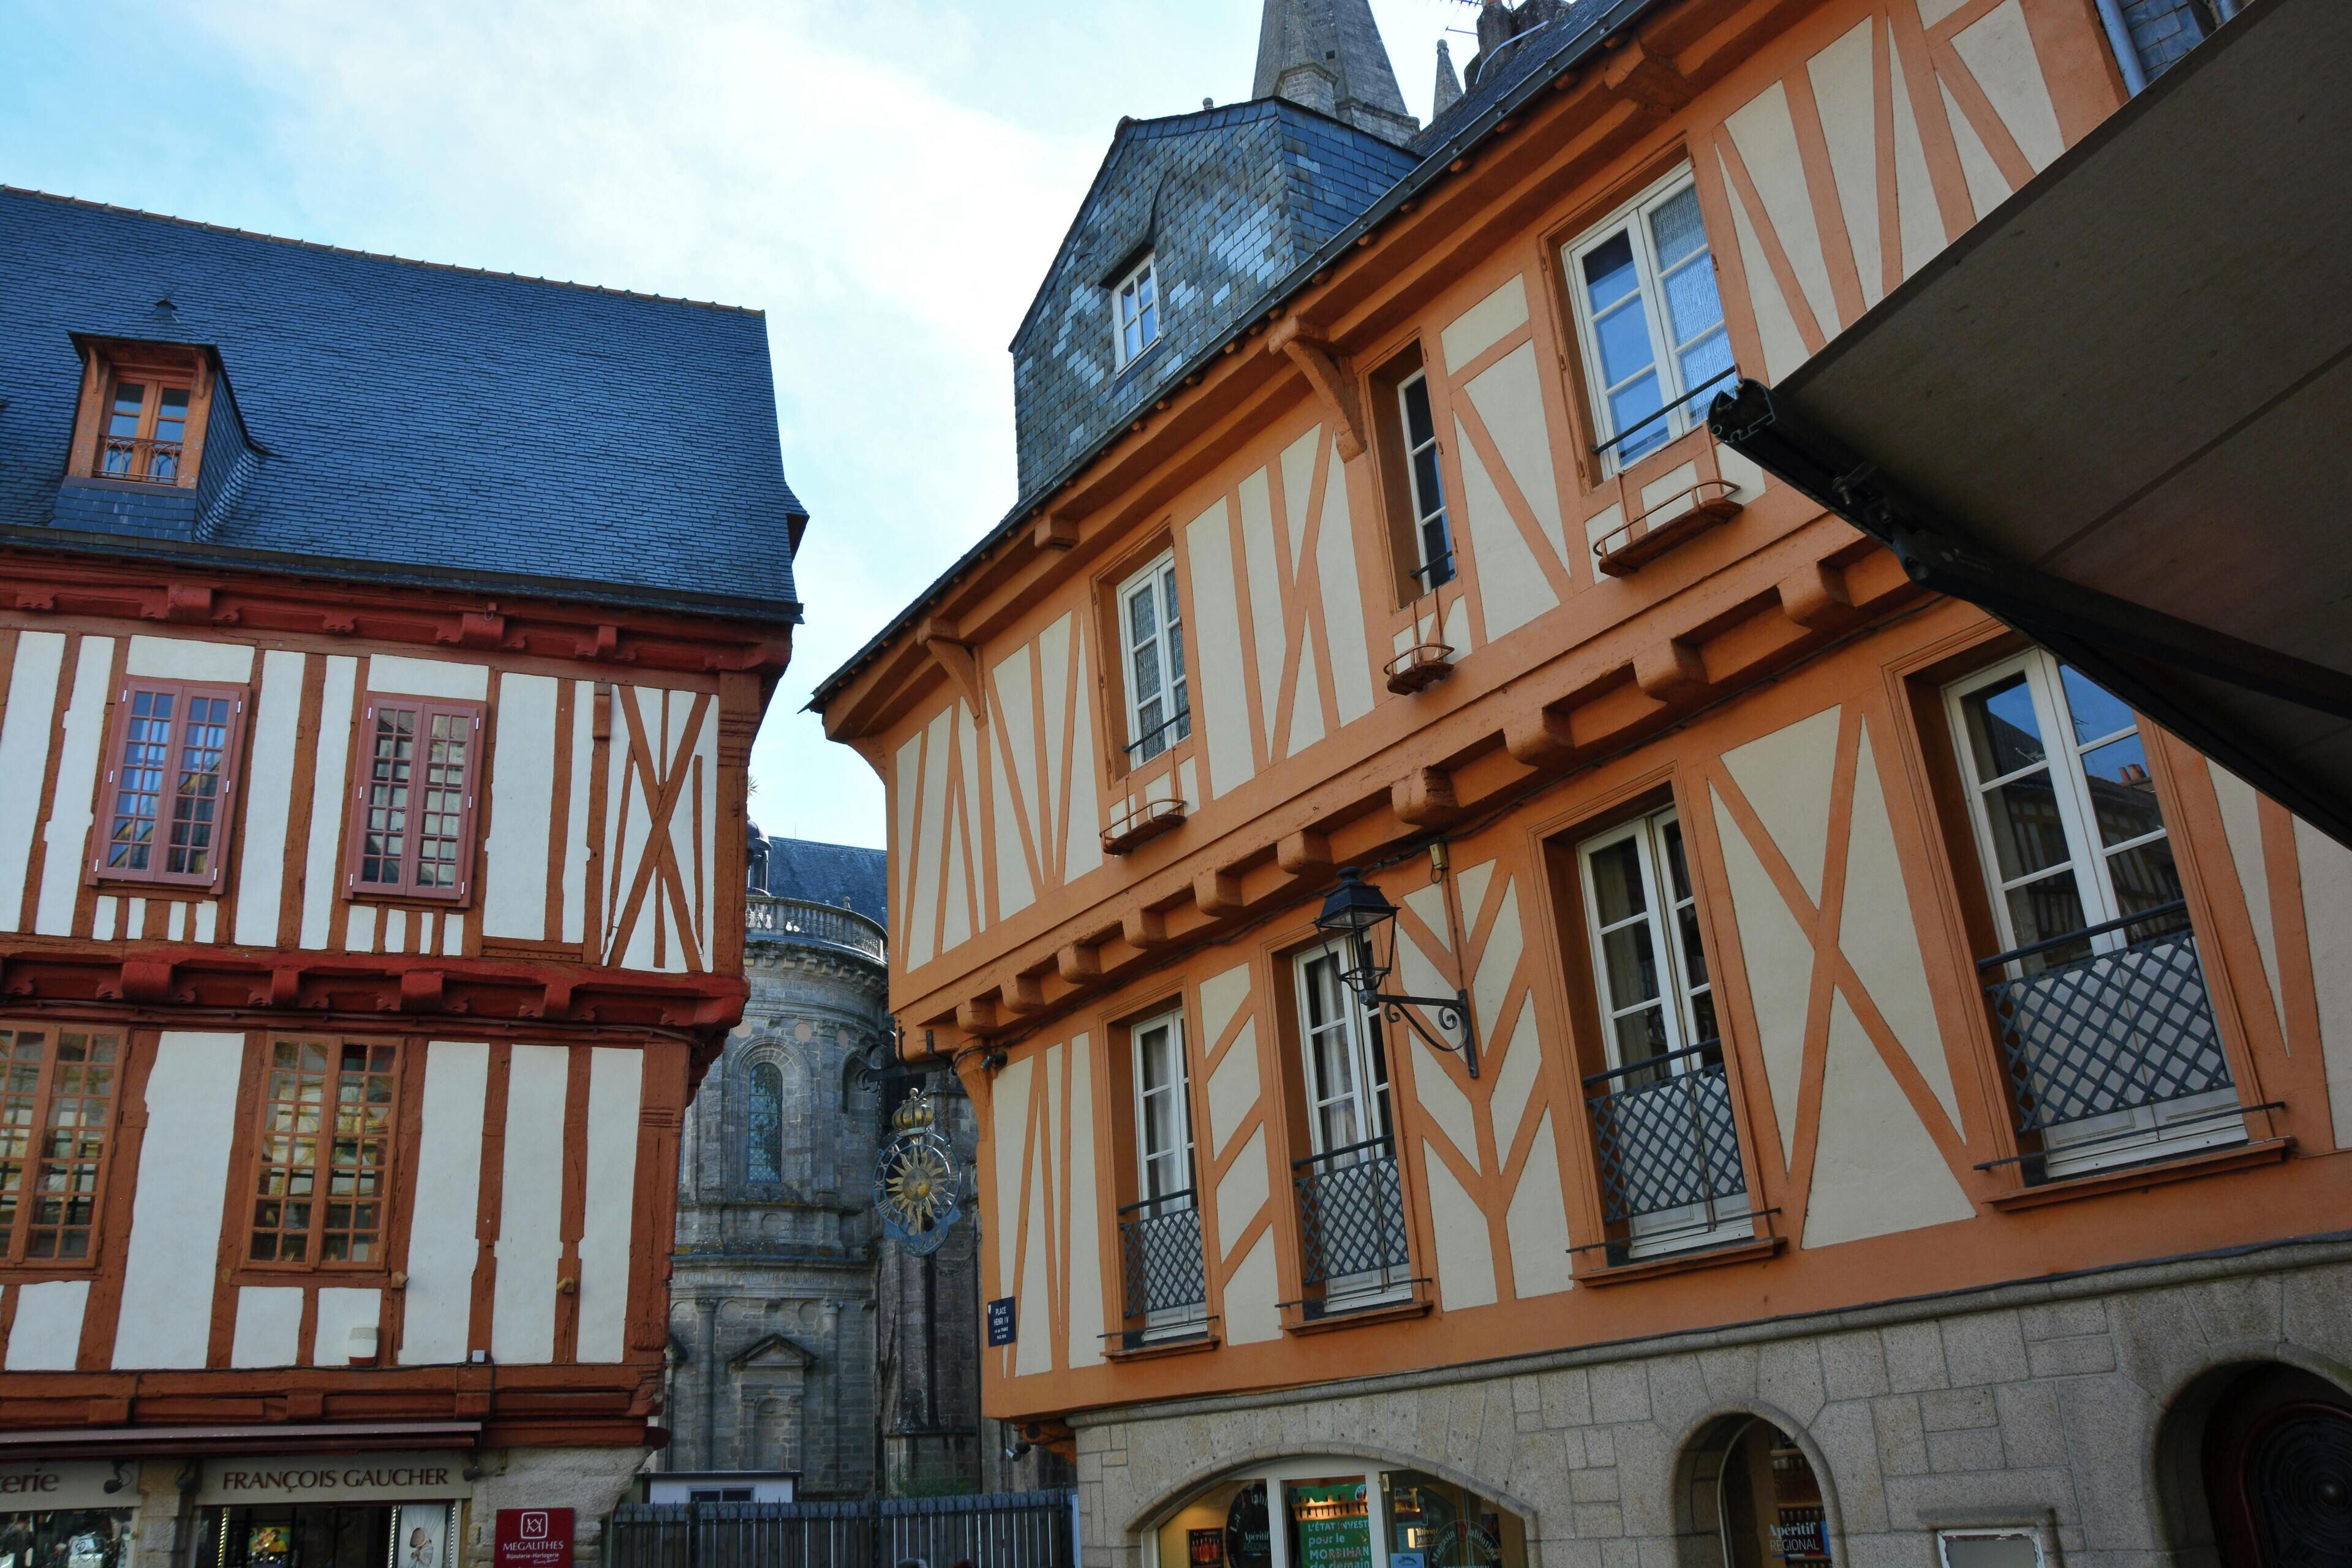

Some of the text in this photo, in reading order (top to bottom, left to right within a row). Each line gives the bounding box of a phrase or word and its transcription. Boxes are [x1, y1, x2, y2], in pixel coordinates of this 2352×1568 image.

[995, 1306, 1006, 1315] PLACE
[993, 1317, 1003, 1326] HENRI
[222, 1468, 448, 1492] FRANÇOIS GAUCHER
[1308, 1521, 1335, 1532] L'ÉTAT
[1769, 1523, 1817, 1539] Apéritif
[1244, 1530, 1270, 1543] Apéritif
[1308, 1532, 1345, 1548] pour le
[502, 1540, 564, 1551] MEGALITHES
[1431, 1529, 1455, 1562] Magasin
[1770, 1538, 1820, 1551] REGIONAL
[1310, 1545, 1370, 1560] MORBIHAN
